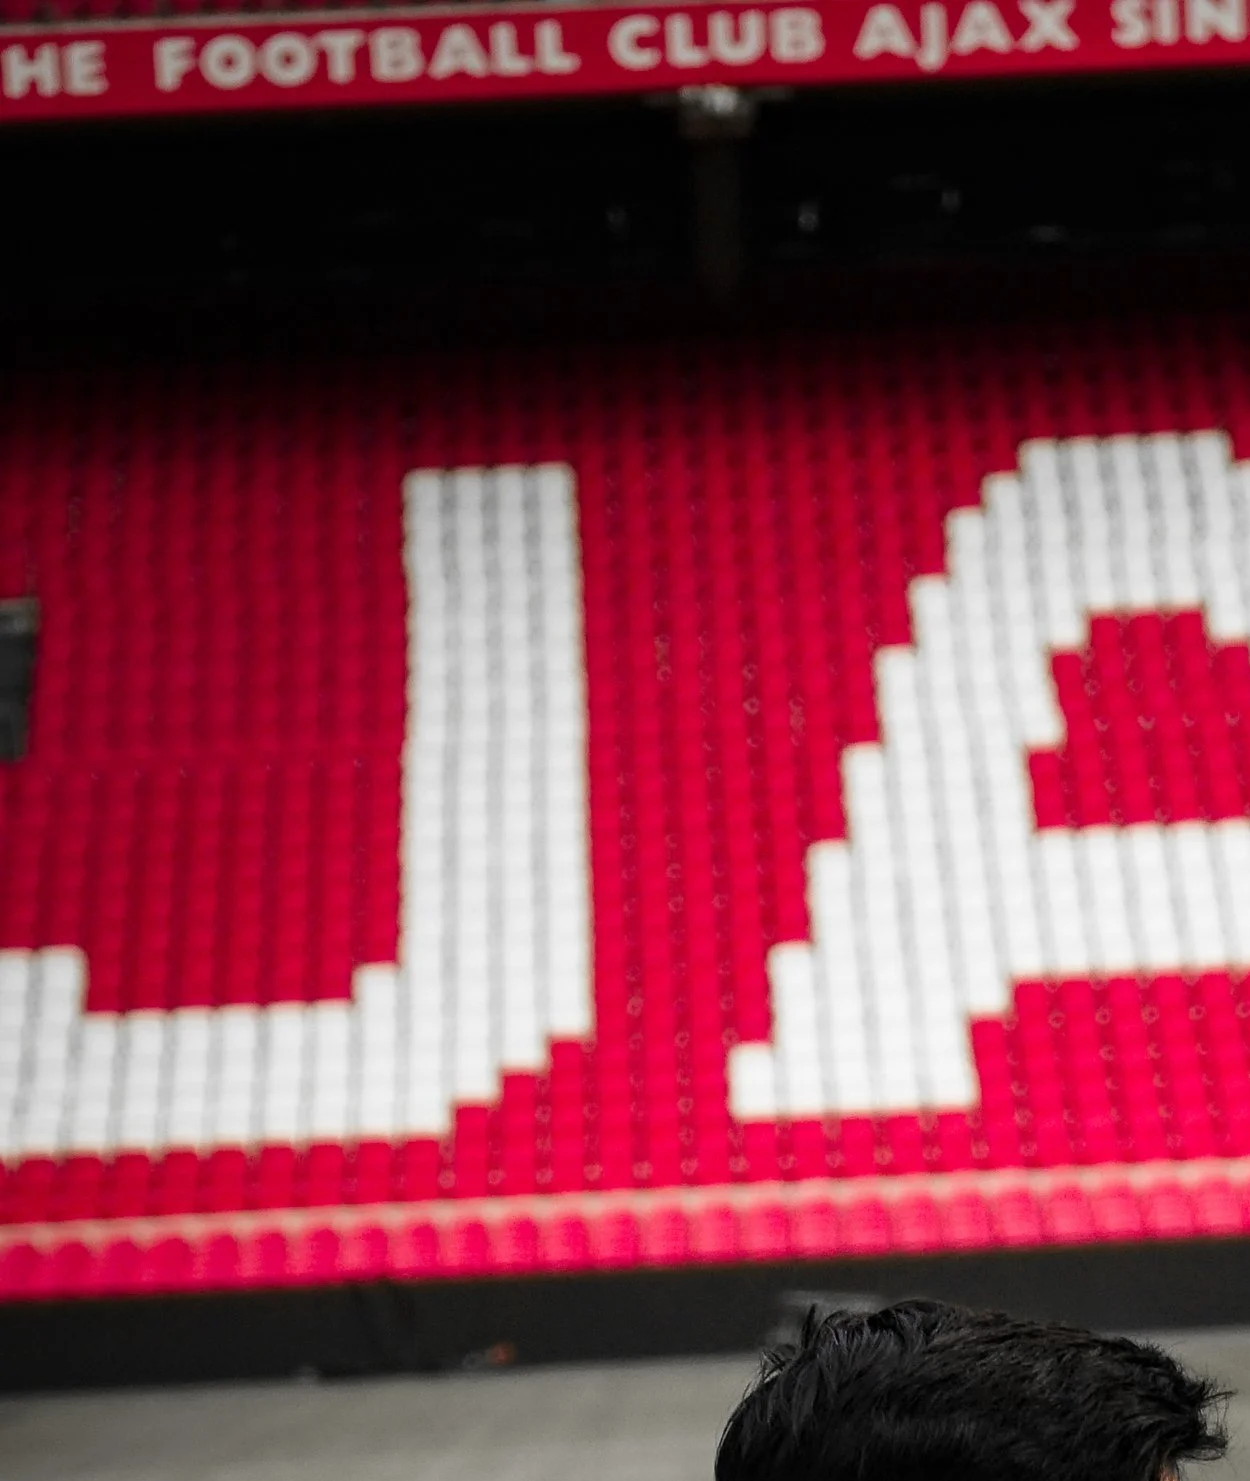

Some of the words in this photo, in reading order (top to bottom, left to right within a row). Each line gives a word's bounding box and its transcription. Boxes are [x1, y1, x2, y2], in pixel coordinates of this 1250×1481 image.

[152, 19, 582, 93] FOOTBALL
[606, 8, 826, 71] CLUB
[852, 0, 1081, 73] AJAX
